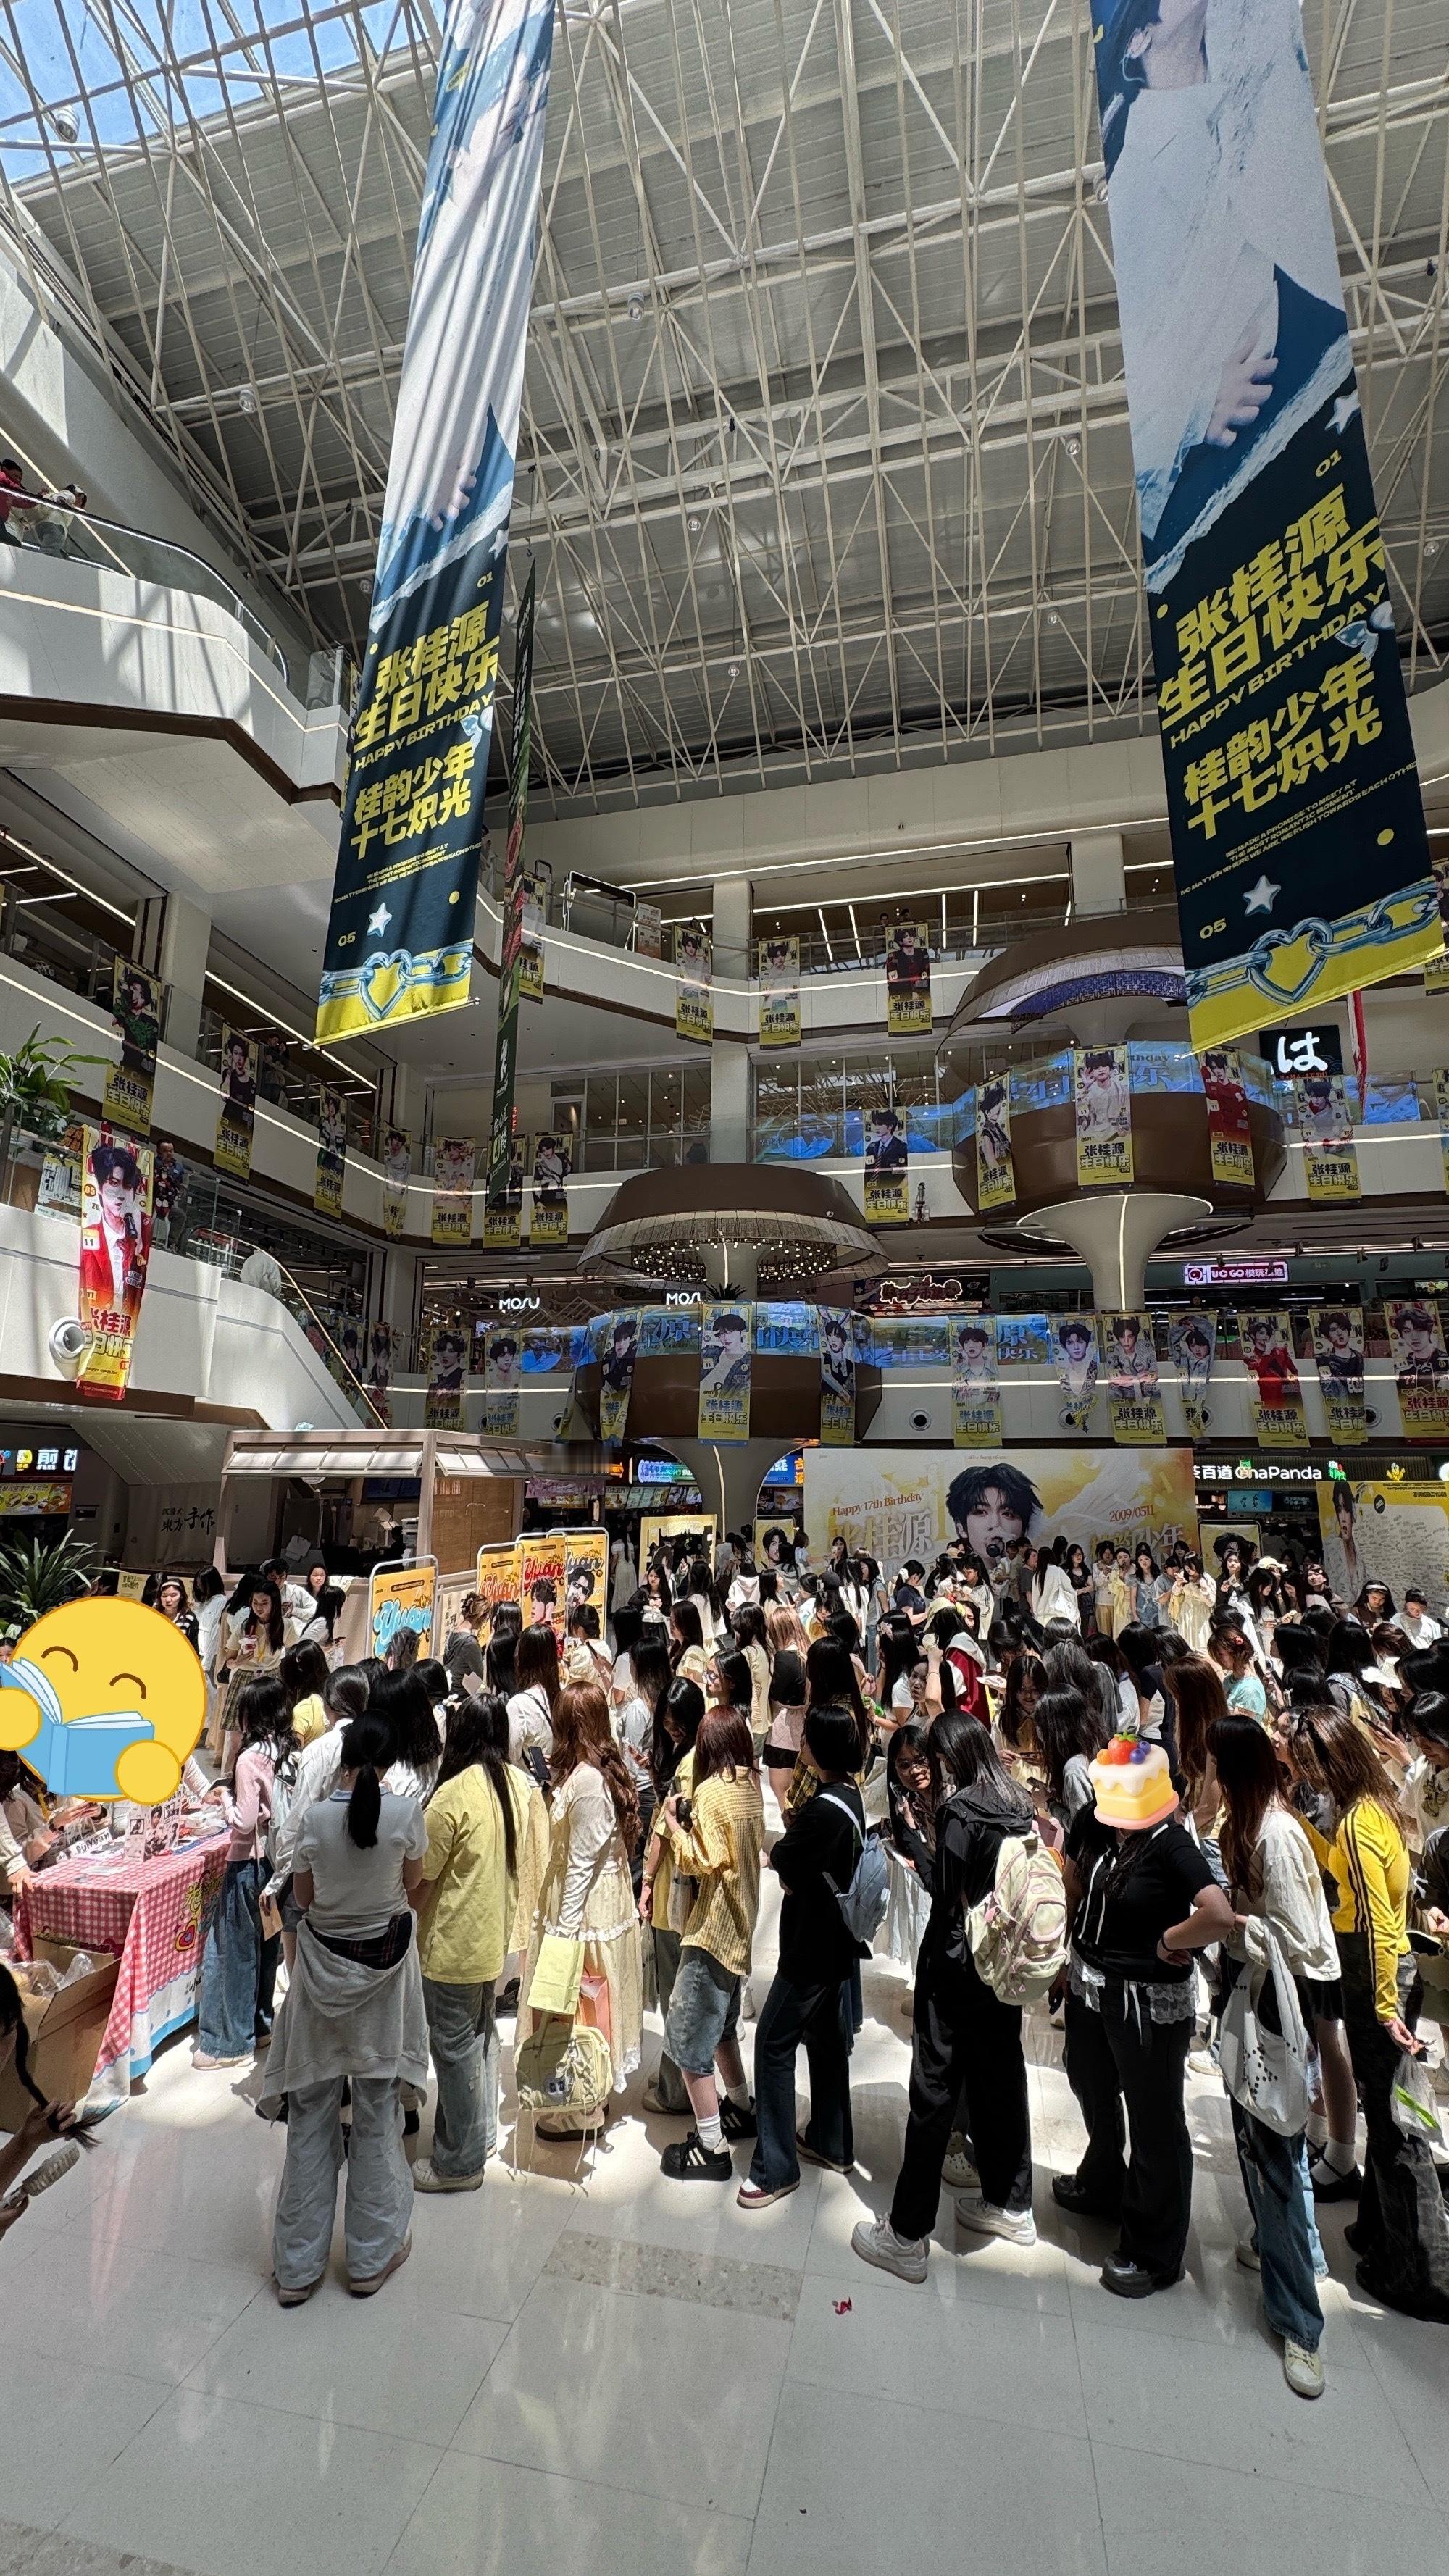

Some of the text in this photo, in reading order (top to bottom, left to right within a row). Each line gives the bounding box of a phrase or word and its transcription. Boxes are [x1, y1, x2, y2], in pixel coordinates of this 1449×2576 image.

[1315, 450, 1342, 477] 01
[477, 571, 493, 588] 01
[1176, 482, 1350, 664] 张桂源
[1158, 517, 1386, 731] 生日快乐
[375, 600, 489, 701] 张桂源
[1170, 583, 1386, 750] HAPPY BIRTHDAY
[353, 635, 499, 753] 生日快乐
[354, 690, 493, 772] HAPPY BIRTHDAY
[1184, 651, 1375, 806] 桂韵少年
[1188, 696, 1382, 840] 十七炽光
[354, 740, 477, 827] 桂韵少年
[1361, 777, 1388, 797] EACH
[1306, 802, 1319, 812] TO
[1344, 779, 1357, 791] AT
[350, 779, 472, 860] 十七炽光
[1200, 918, 1227, 939] 05
[338, 931, 356, 947] 05
[519, 958, 538, 973] 桂源
[1277, 1032, 1328, 1073] は
[1085, 1142, 1125, 1156] 张桂源
[1216, 1141, 1248, 1156] 张桂源
[1079, 1155, 1131, 1171] 生日快乐
[1213, 1150, 1253, 1169] 生日快乐
[1312, 1162, 1351, 1175] 张桂源
[1309, 1174, 1358, 1187] 生日快乐
[870, 1188, 903, 1200] 张桂源
[866, 1197, 908, 1210] 生日快乐
[433, 1221, 471, 1234] 生日快乐
[84, 1238, 93, 1247] 11
[498, 1297, 540, 1310] MOSU
[706, 1399, 743, 1412] 张桂源
[1118, 1407, 1157, 1418] 张桂源
[701, 1412, 747, 1425] 生日快乐
[1258, 1409, 1298, 1422] 张桂源
[956, 1421, 1000, 1434] 生日快乐
[1114, 1417, 1163, 1431] 生日快乐
[1256, 1420, 1306, 1435] 生日快乐
[833, 1492, 924, 1517] Happy 17th Birthday
[1109, 1505, 1155, 1522] 2009/0511
